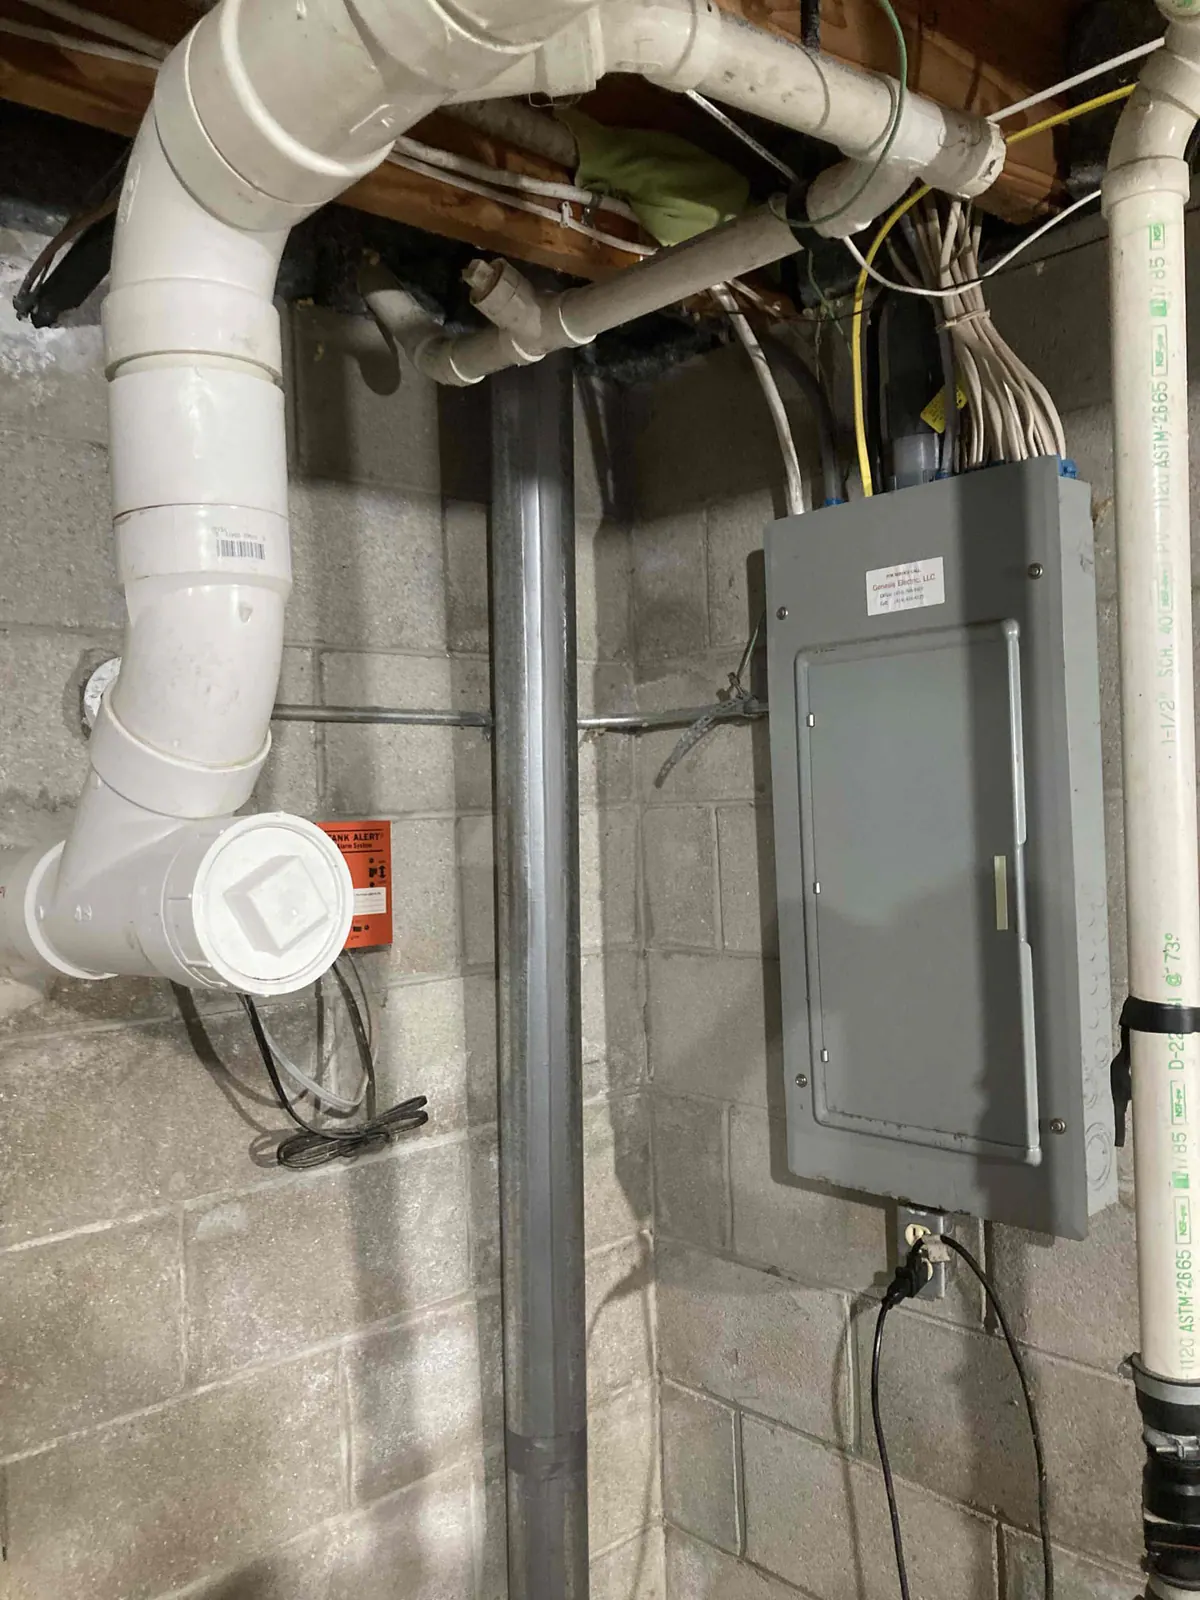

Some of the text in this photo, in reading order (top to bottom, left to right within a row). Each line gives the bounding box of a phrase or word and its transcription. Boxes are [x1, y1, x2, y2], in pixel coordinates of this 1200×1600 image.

[923, 573, 936, 582] LLC
[1157, 616, 1174, 635] 40
[353, 832, 380, 841] ALERT
